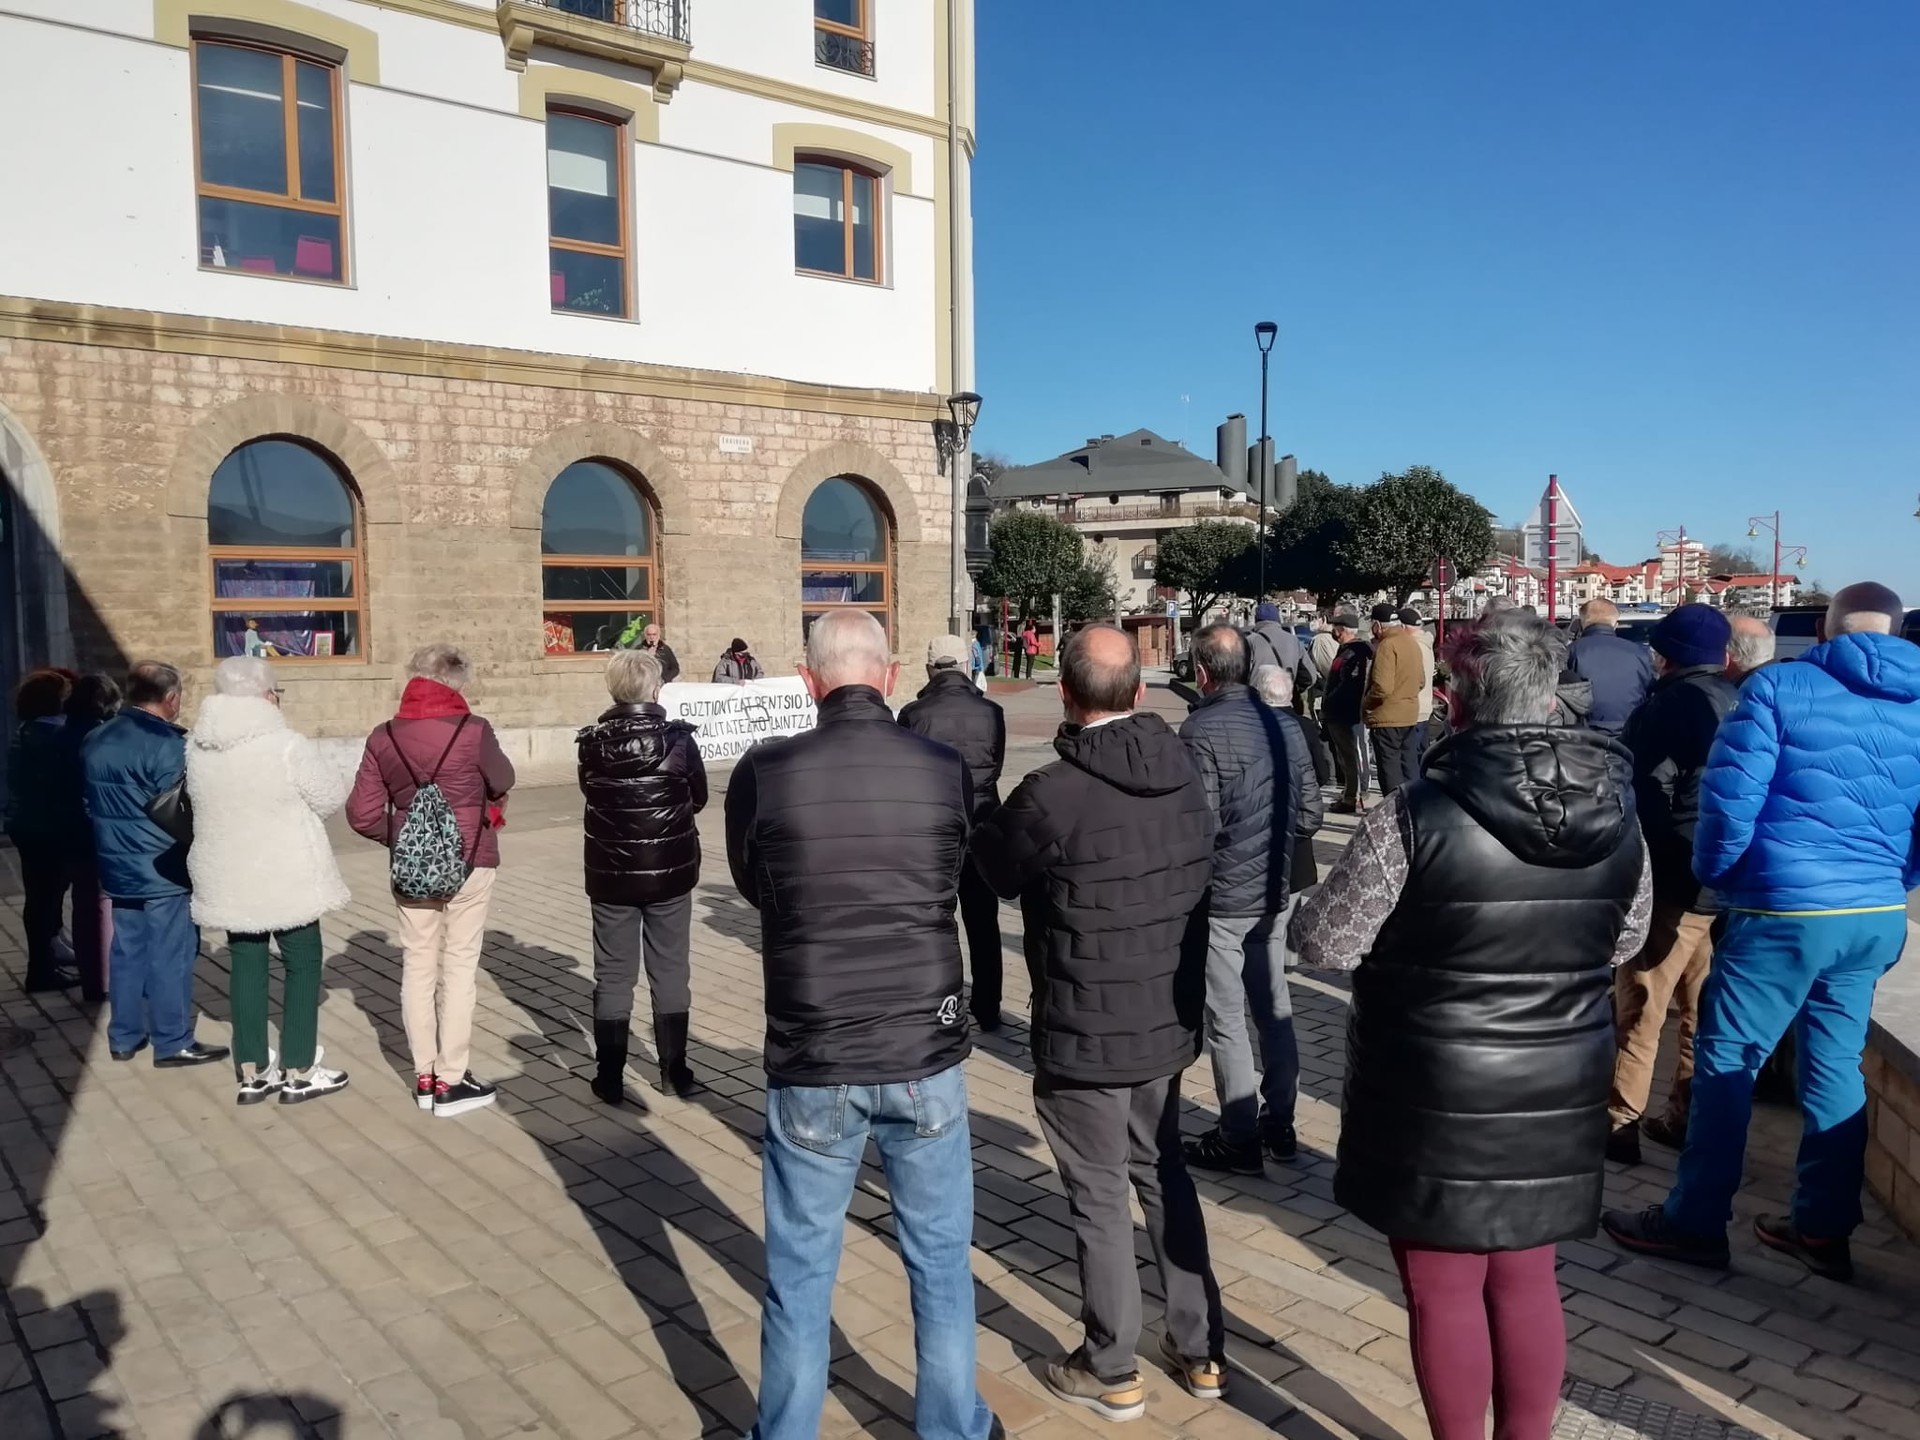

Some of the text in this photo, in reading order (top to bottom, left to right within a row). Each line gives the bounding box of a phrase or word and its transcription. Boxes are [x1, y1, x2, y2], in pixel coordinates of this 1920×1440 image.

[680, 696, 752, 717] GUZTIONTZAT
[754, 693, 803, 711] PENTSIO
[694, 713, 813, 739] KALITATEZKO ZAINTZA
